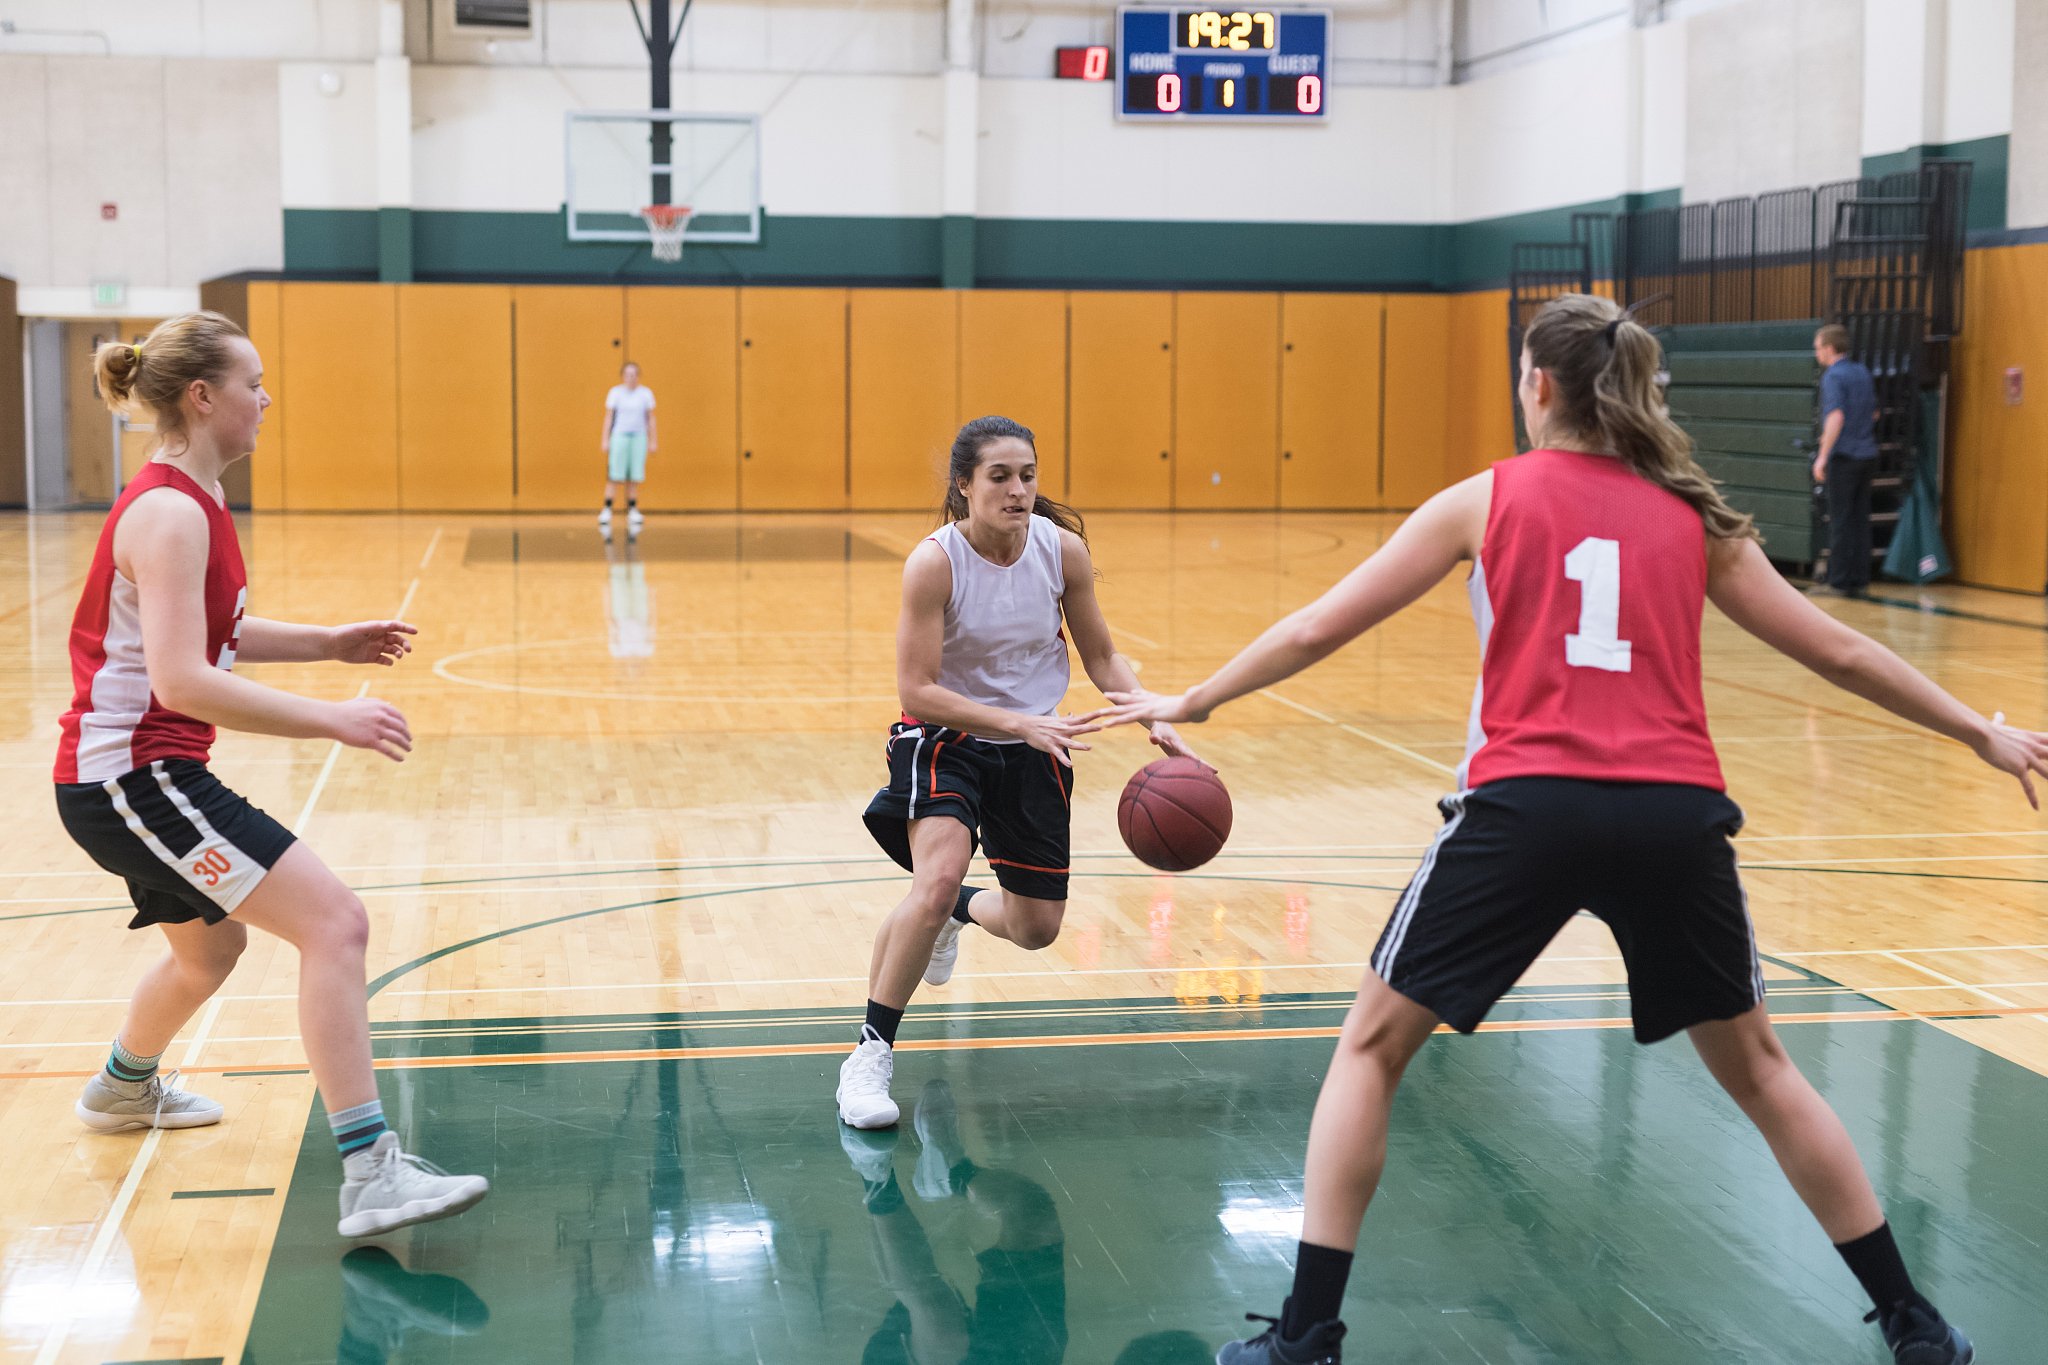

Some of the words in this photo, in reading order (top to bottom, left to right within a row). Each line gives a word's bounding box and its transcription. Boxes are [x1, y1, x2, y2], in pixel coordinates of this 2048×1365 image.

[1188, 12, 1274, 51] 19:27
[1083, 47, 1108, 81] 0
[1129, 52, 1177, 73] HOME
[1267, 54, 1320, 75] GUEST
[1157, 74, 1181, 112] 0
[1223, 79, 1234, 107] 1
[1297, 75, 1321, 113] 0
[1564, 536, 1632, 673] 1
[192, 848, 232, 887] 30
